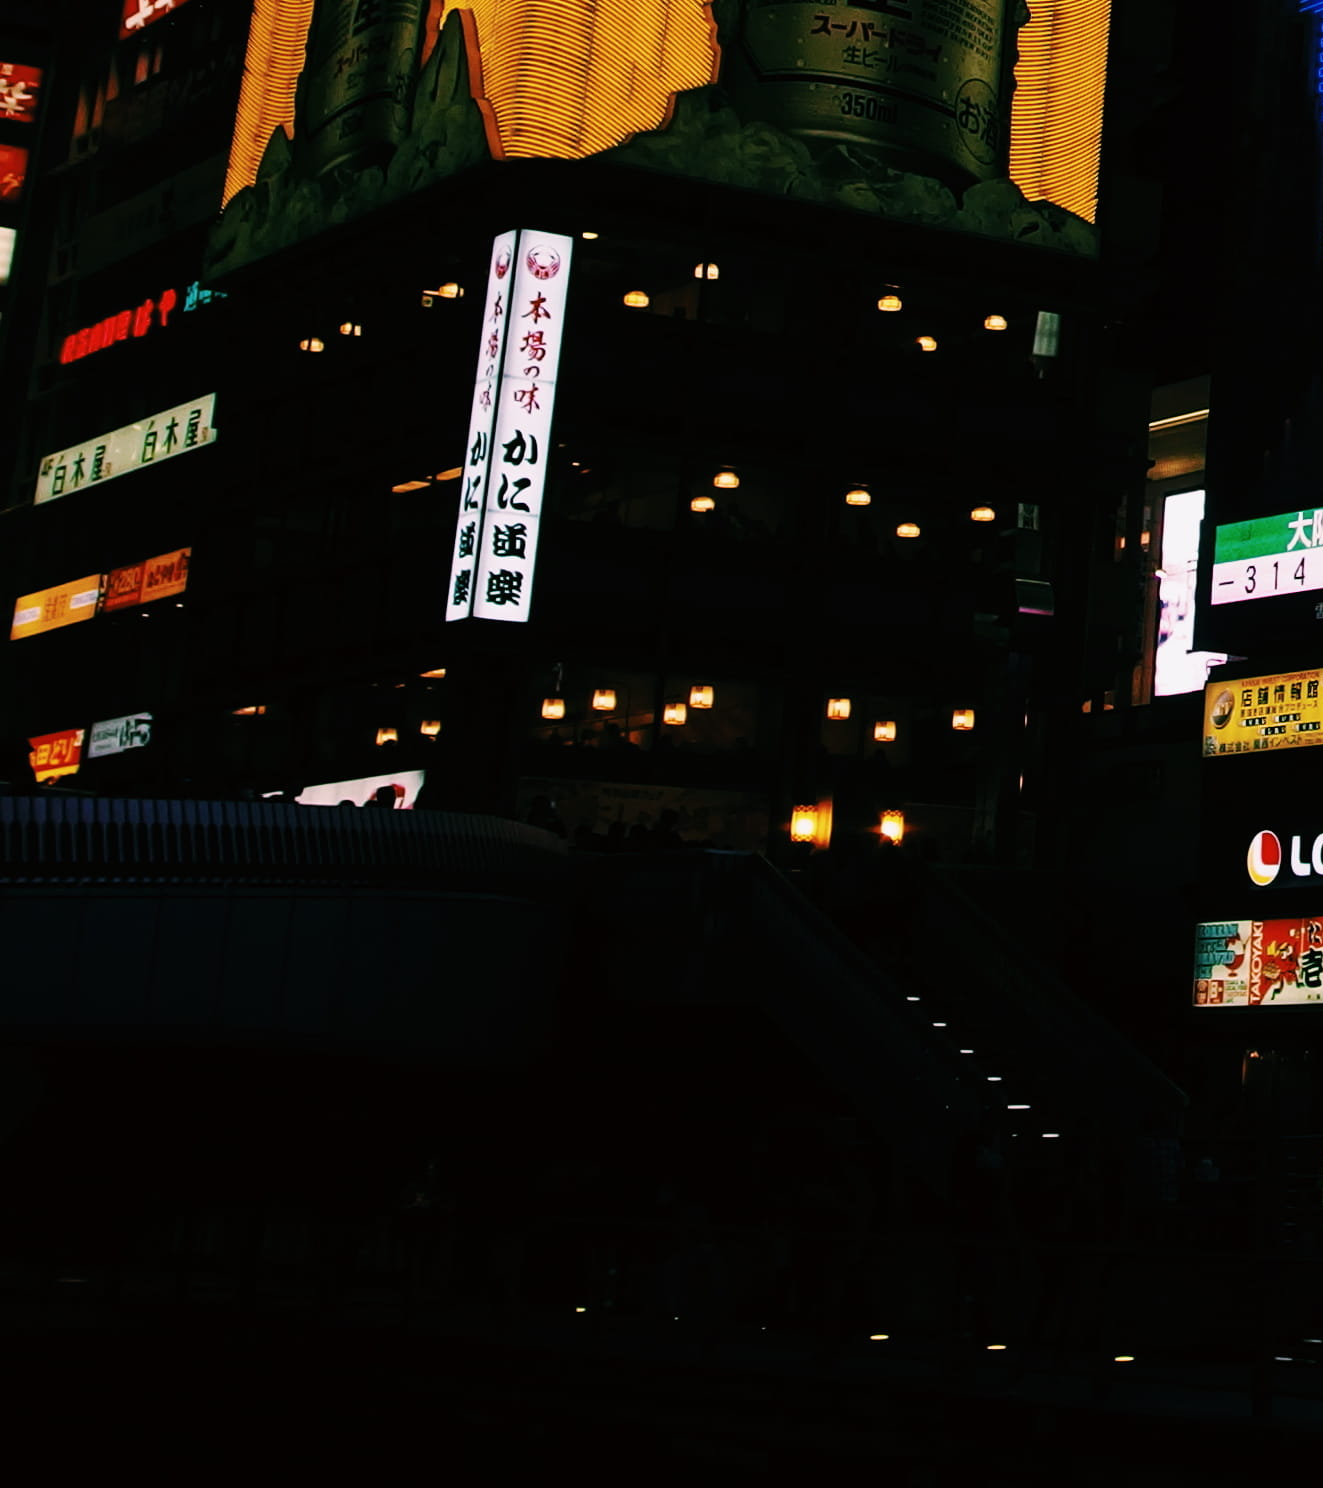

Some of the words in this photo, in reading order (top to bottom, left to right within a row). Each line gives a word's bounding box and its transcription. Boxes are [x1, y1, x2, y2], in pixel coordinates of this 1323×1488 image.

[513, 291, 552, 415] 本場の味
[1251, 921, 1264, 1001] TAKOYAKI
